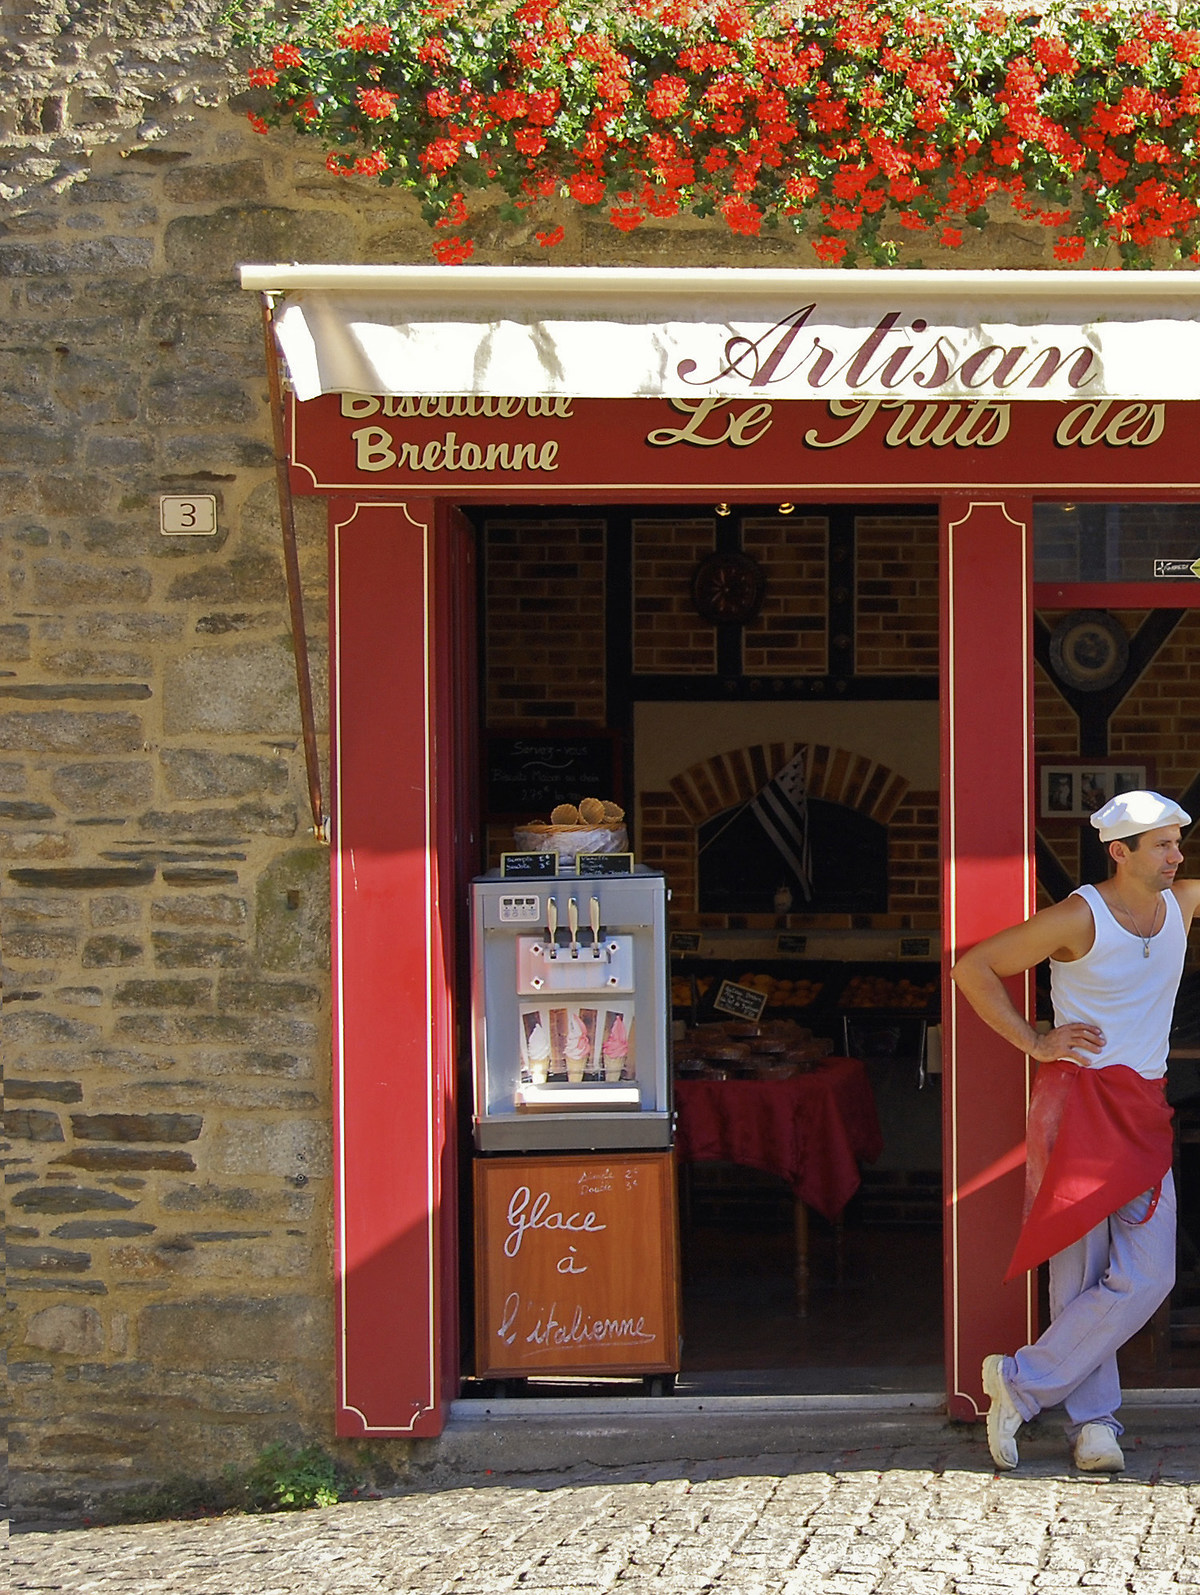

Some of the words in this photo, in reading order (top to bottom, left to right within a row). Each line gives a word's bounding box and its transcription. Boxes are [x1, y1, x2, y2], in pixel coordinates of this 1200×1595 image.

[677, 302, 1098, 389] Artisan
[351, 425, 559, 472] Bretonne
[647, 397, 773, 447] Le
[804, 398, 1012, 449] Puits
[1056, 398, 1167, 447] des
[180, 502, 197, 528] 3
[503, 1186, 607, 1258] Glace
[556, 1246, 588, 1275] à
[497, 1292, 656, 1346] l'italienne
